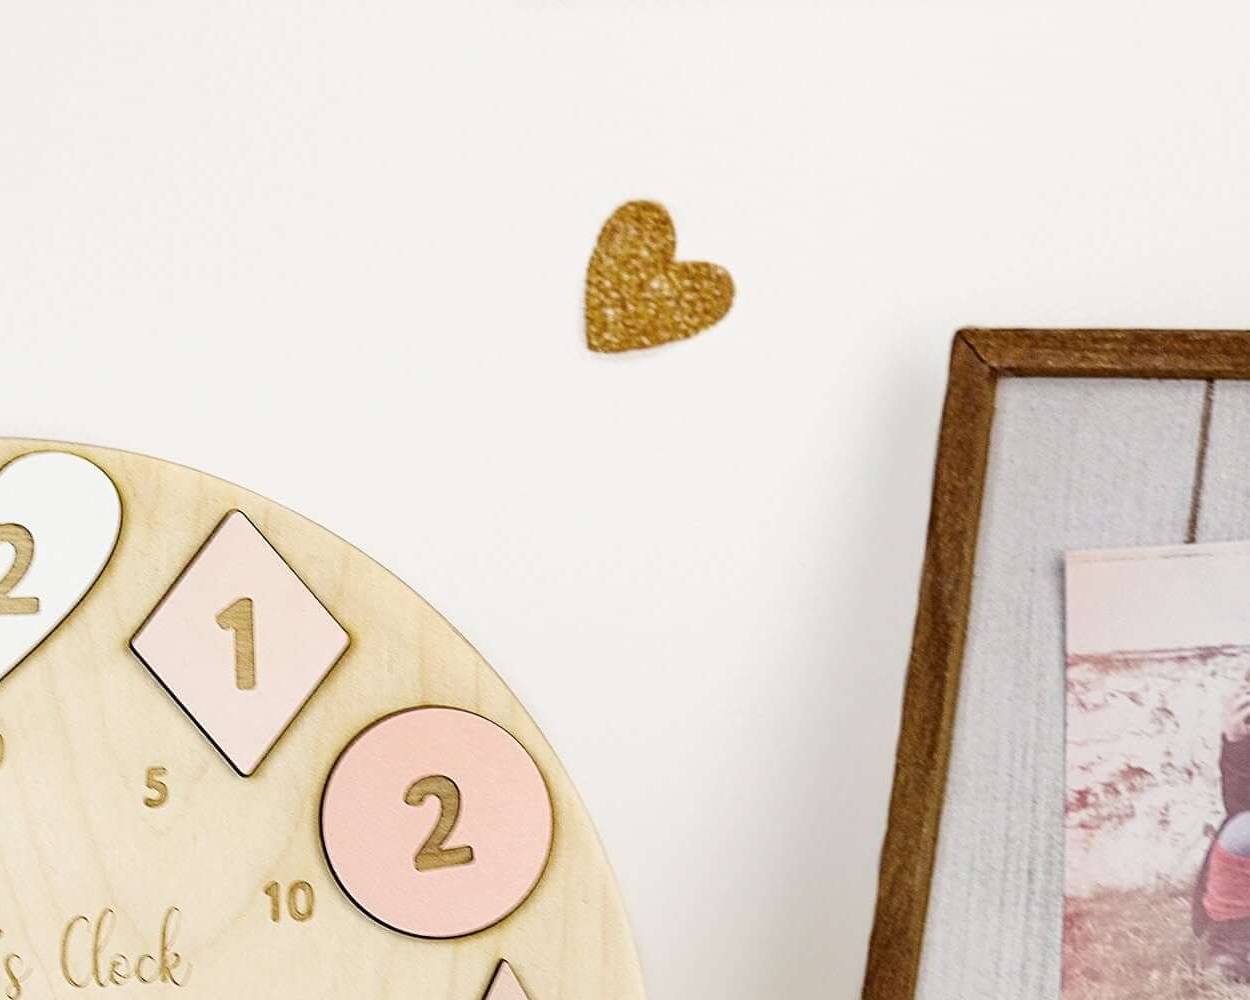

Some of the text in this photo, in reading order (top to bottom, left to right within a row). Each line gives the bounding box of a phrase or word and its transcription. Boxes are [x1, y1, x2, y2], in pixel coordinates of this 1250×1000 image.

[215, 597, 256, 690] 1
[143, 767, 168, 808] 5
[403, 774, 475, 872] 2
[263, 880, 315, 923] 10
[59, 905, 193, 989] Clock
